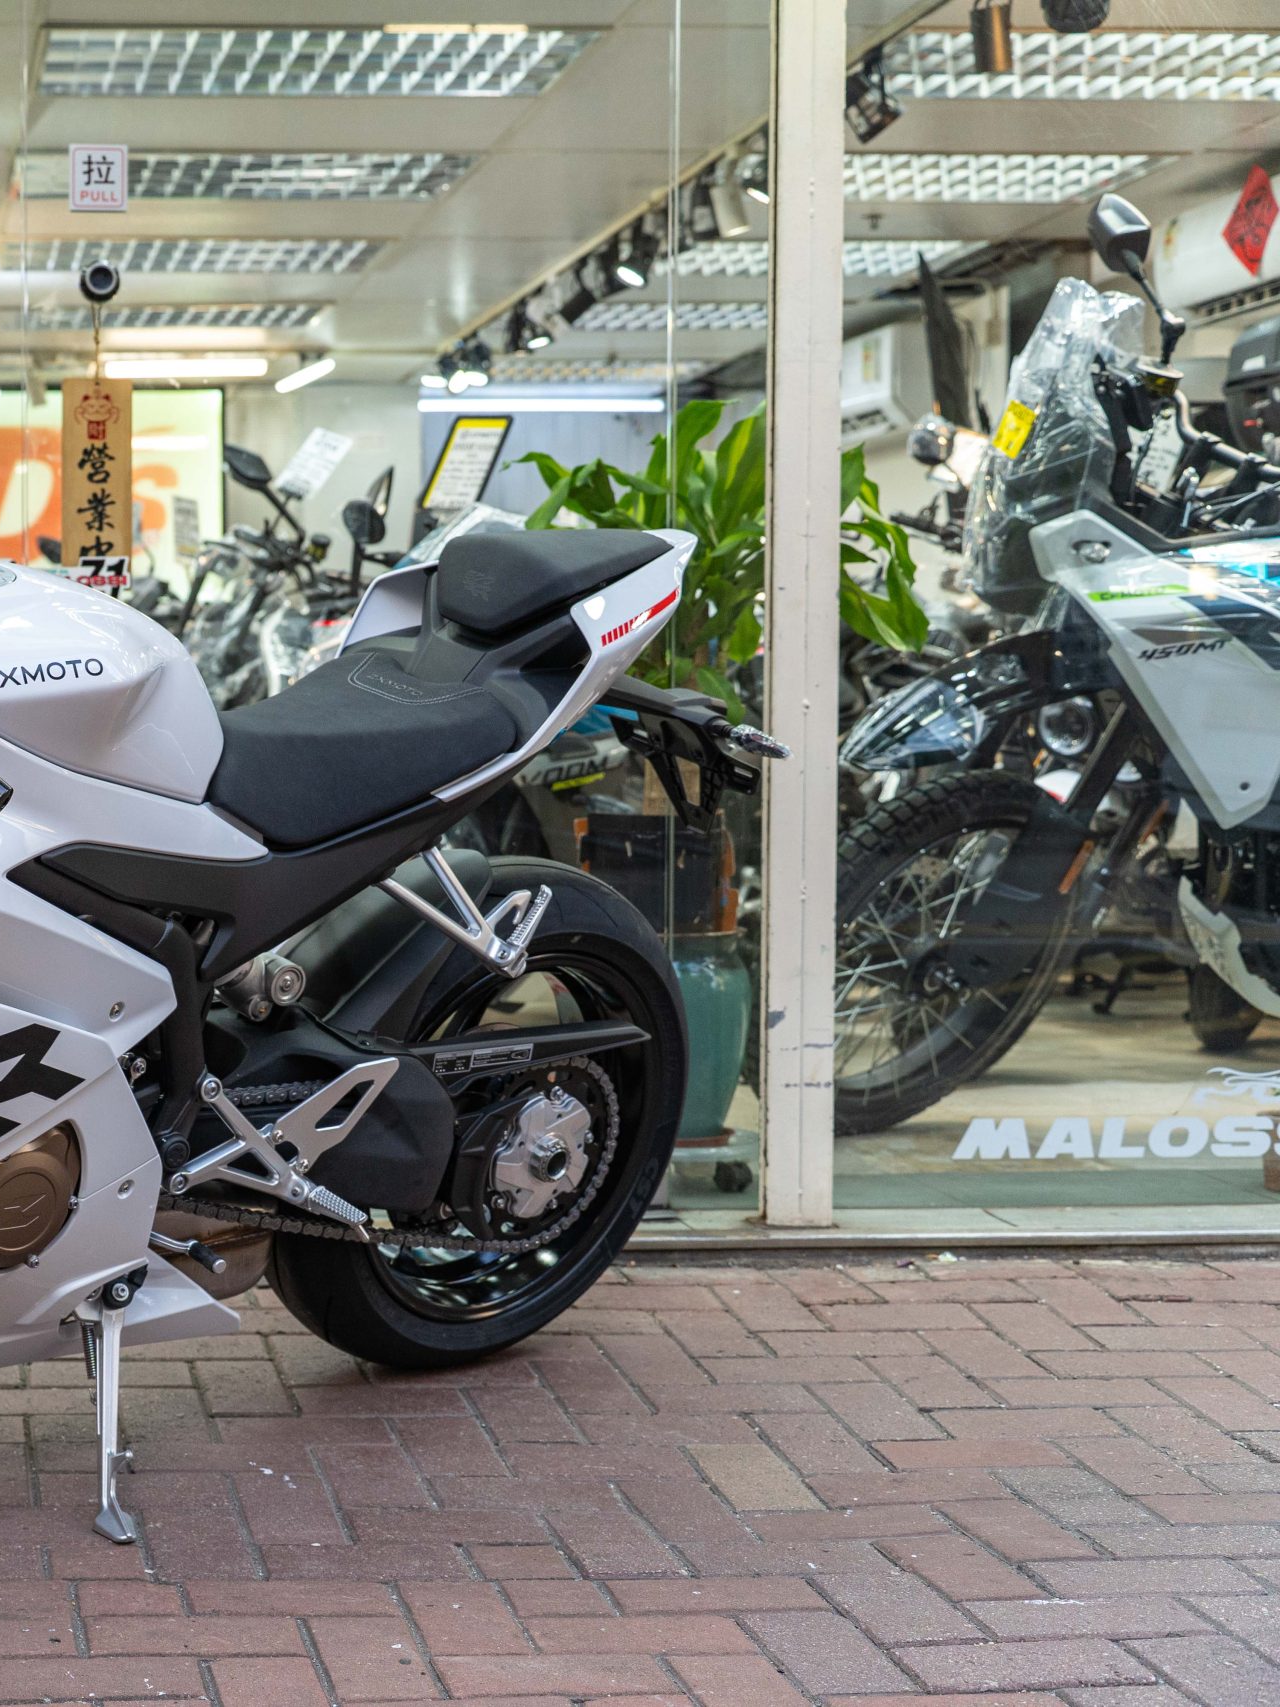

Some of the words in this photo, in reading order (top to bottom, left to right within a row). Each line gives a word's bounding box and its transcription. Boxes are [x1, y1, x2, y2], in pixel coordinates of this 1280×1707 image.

[81, 154, 116, 186] 拉
[80, 190, 118, 202] PULL
[1138, 640, 1227, 661] 450MT
[951, 1115, 1280, 1161] MALOS
